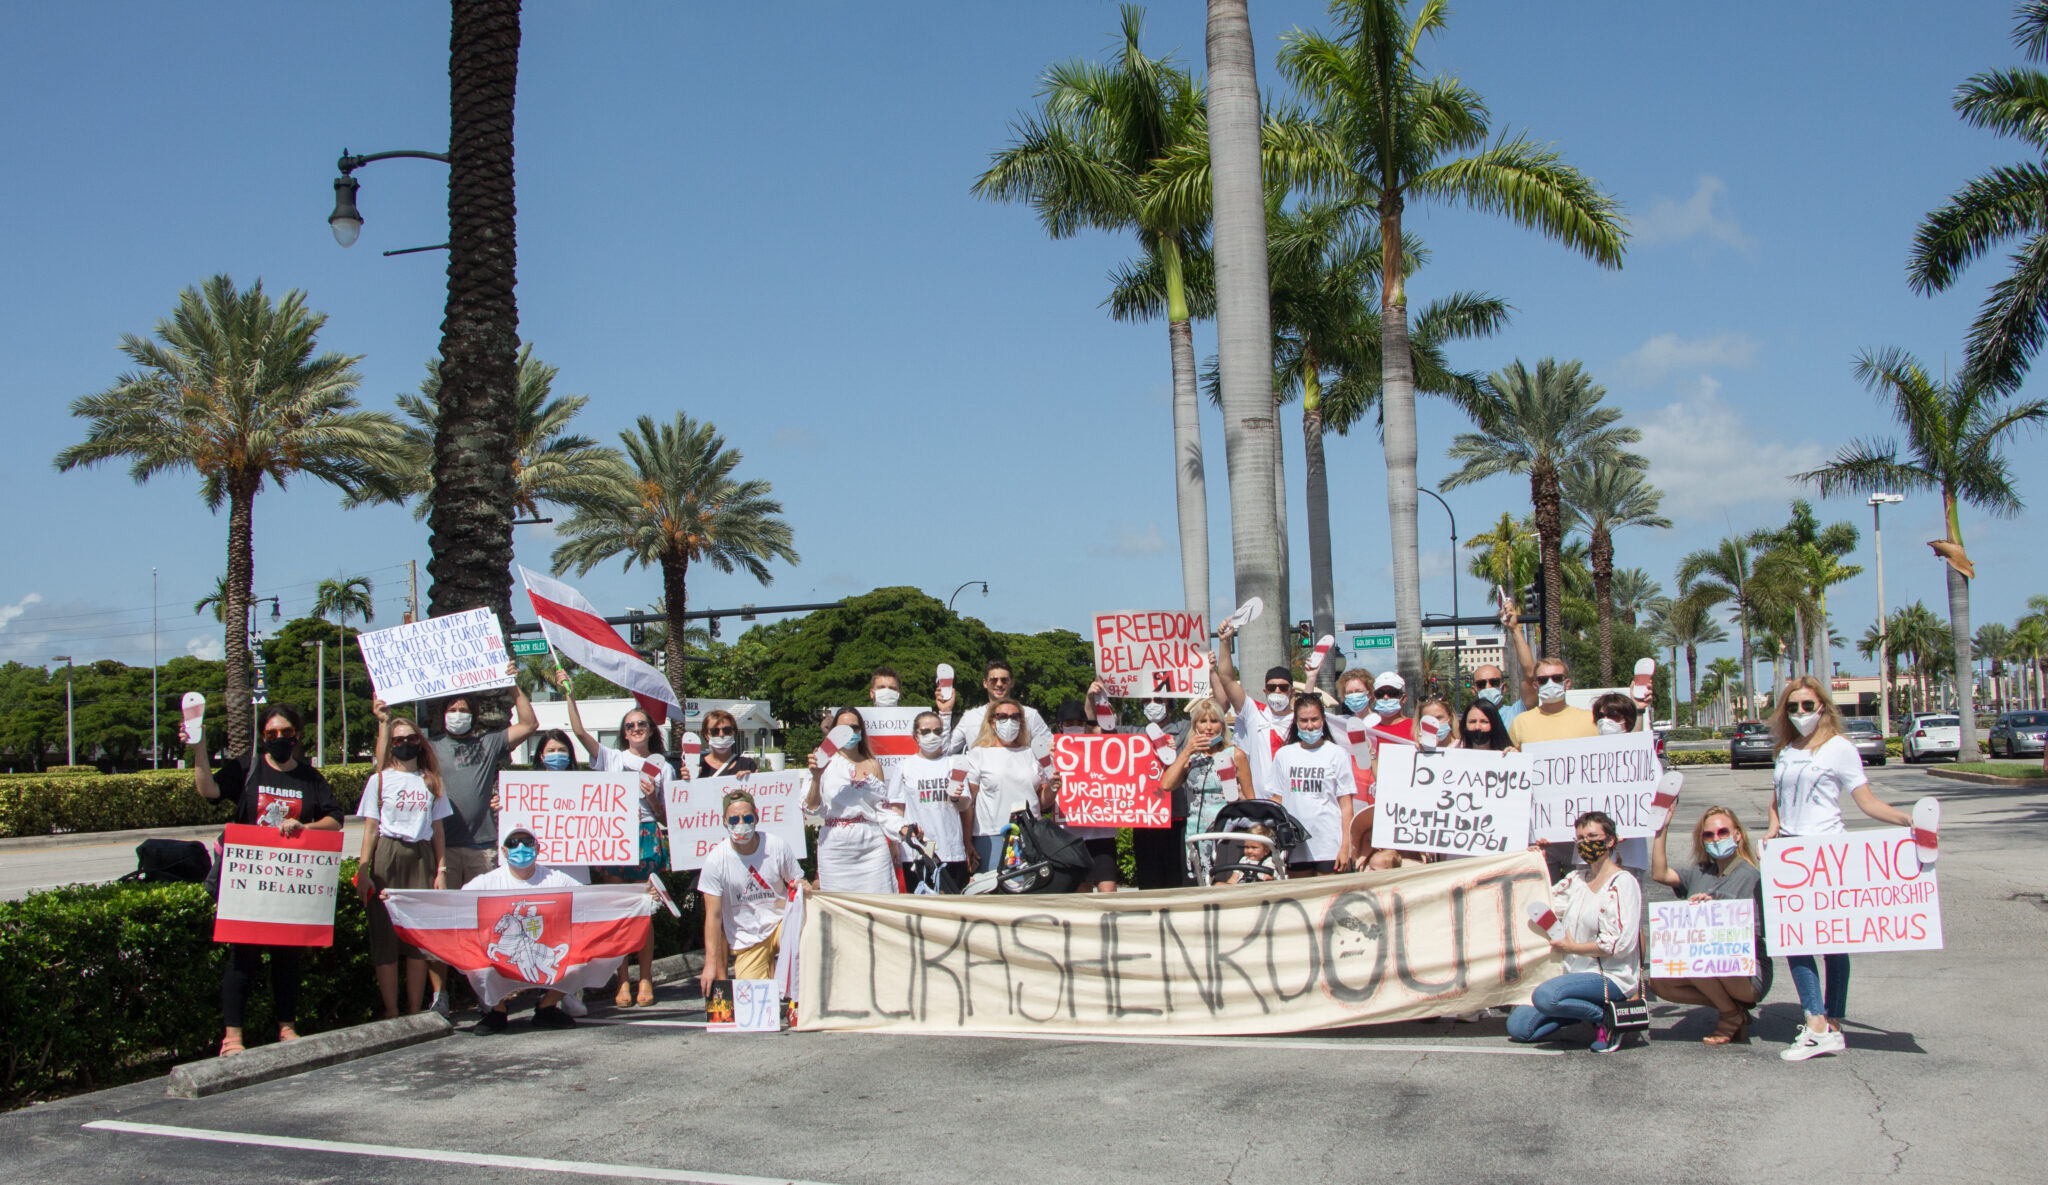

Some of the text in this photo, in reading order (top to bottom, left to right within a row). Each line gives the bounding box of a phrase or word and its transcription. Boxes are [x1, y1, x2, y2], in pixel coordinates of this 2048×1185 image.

[361, 610, 490, 648] THERE IS A COUNTRY IN
[364, 622, 493, 663] THE CENTER OF EUROPE
[1096, 612, 1206, 648] FREEDOM
[368, 656, 411, 677] WHERE
[410, 647, 448, 668] PEOPLE
[469, 639, 484, 654] TO
[485, 635, 504, 652] JAIL
[1101, 640, 1204, 674] BELARUS
[376, 671, 404, 691] JUST
[407, 667, 431, 684] FOR
[431, 655, 485, 677] SPEAKING
[414, 678, 447, 697] OWN
[451, 667, 498, 688] OPINION
[1120, 674, 1139, 684] ARE
[1193, 681, 1209, 697] 97%
[1056, 735, 1151, 777] STOP
[1090, 772, 1107, 780] the
[1289, 766, 1325, 779] NEVER
[1532, 756, 1575, 786] STOP
[258, 785, 303, 799] BELARUS
[505, 783, 550, 812] FREE
[581, 783, 628, 813] FAIR
[672, 786, 689, 803] In
[396, 801, 428, 813] 97%
[678, 809, 720, 829] with
[1534, 802, 1552, 830] IN
[532, 814, 627, 840] ELECTIONS
[226, 847, 340, 866] FREE POLITICAL
[536, 838, 632, 863] BELARUS
[1773, 838, 1924, 889] SAY NO
[229, 861, 314, 879] PRISONERS
[230, 878, 247, 890] IN
[1773, 882, 1935, 913] TO DICTATORSHIP
[1658, 901, 1751, 931] SHAME TO
[1780, 913, 1928, 947] IN BELARUS
[1651, 929, 1706, 949] POLICE
[1664, 942, 1750, 957] TO DICTATOR
[819, 897, 1321, 1027] LUKASHENKO
